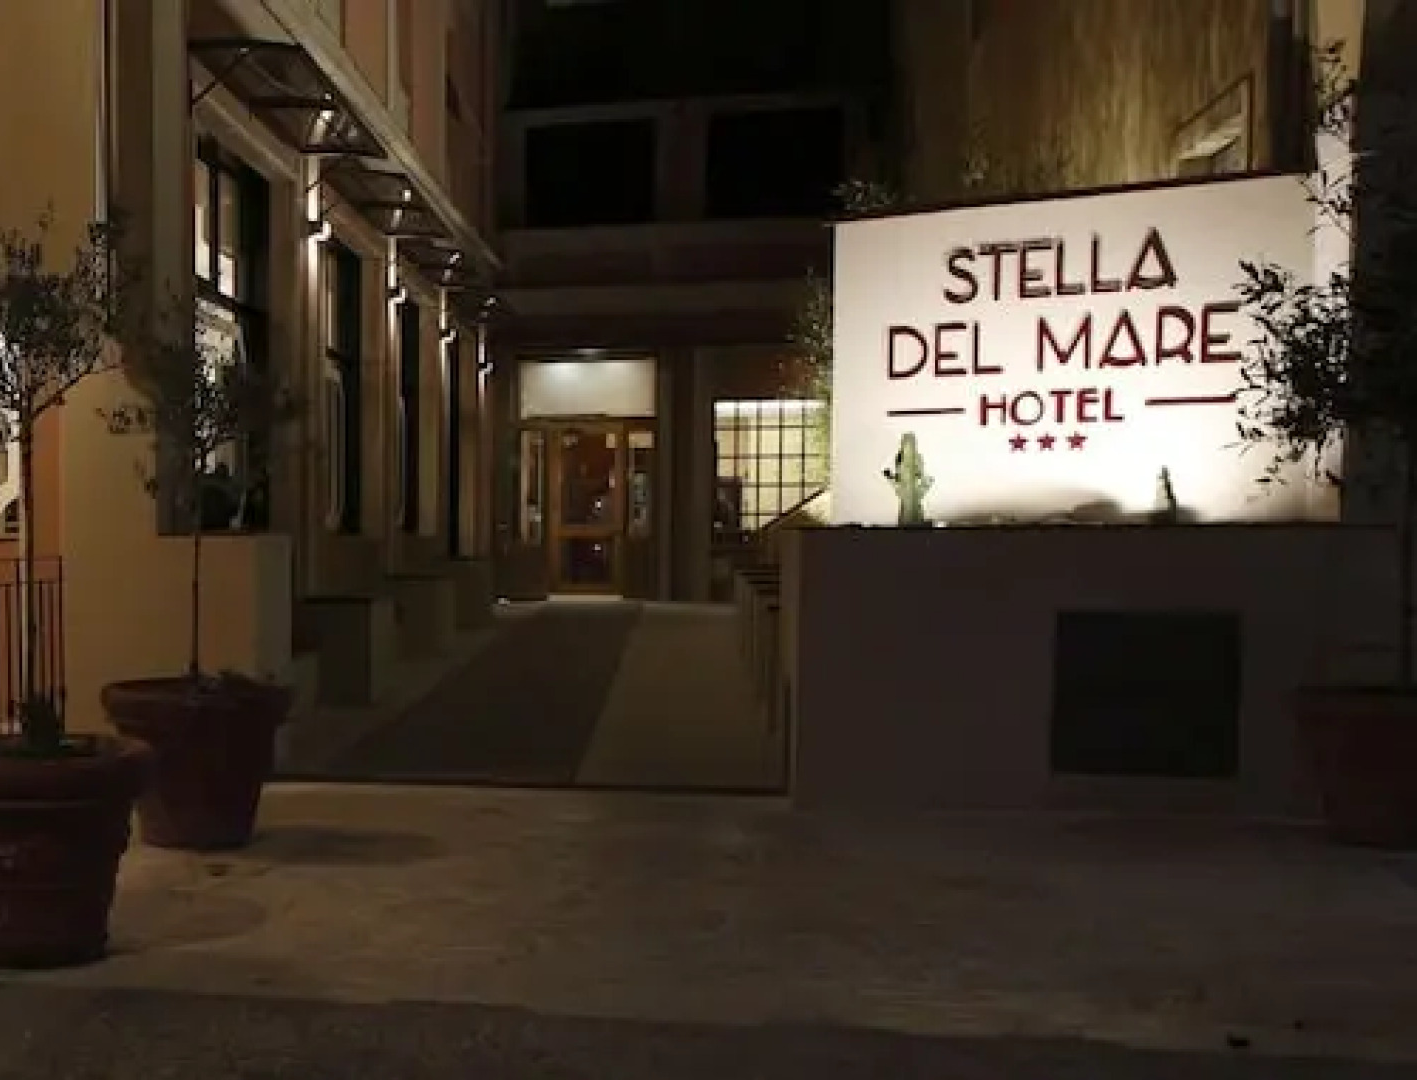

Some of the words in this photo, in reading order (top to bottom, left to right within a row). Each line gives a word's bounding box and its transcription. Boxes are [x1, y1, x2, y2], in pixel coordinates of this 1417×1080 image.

[944, 227, 1178, 304] STELLA
[887, 321, 1003, 379] DEL
[1037, 301, 1243, 373] MARE
[980, 387, 1125, 426] HOTEL
